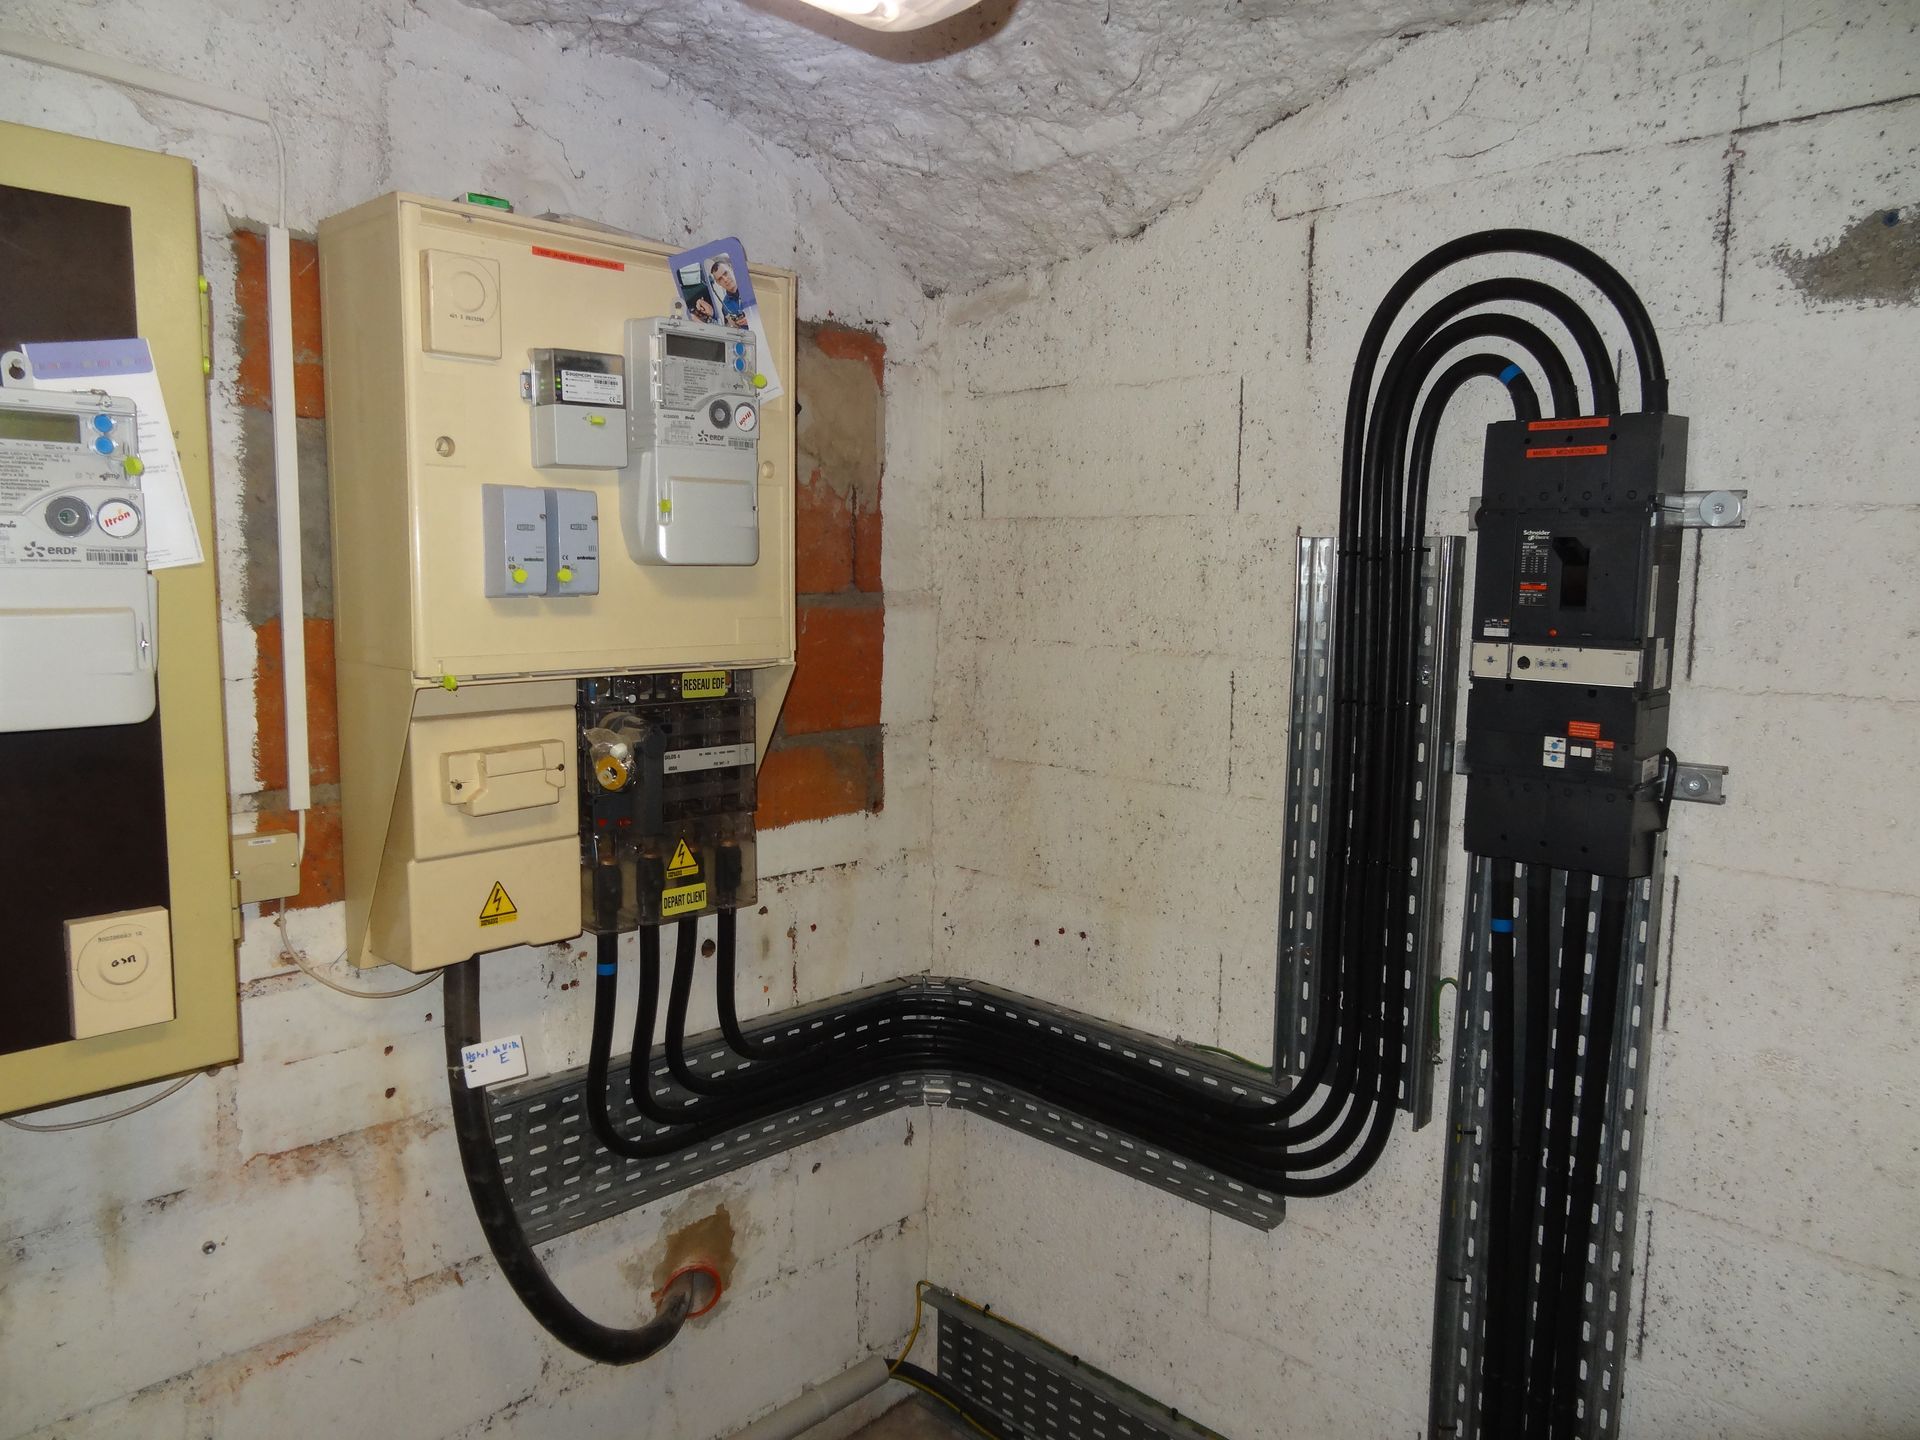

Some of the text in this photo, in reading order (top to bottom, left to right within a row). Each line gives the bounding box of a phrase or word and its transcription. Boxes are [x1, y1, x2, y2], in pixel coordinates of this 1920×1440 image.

[104, 510, 131, 528] Itron
[47, 546, 77, 555] eRDF
[684, 677, 725, 691] RESEAU EDF
[664, 890, 705, 909] DEPART CLIENT
